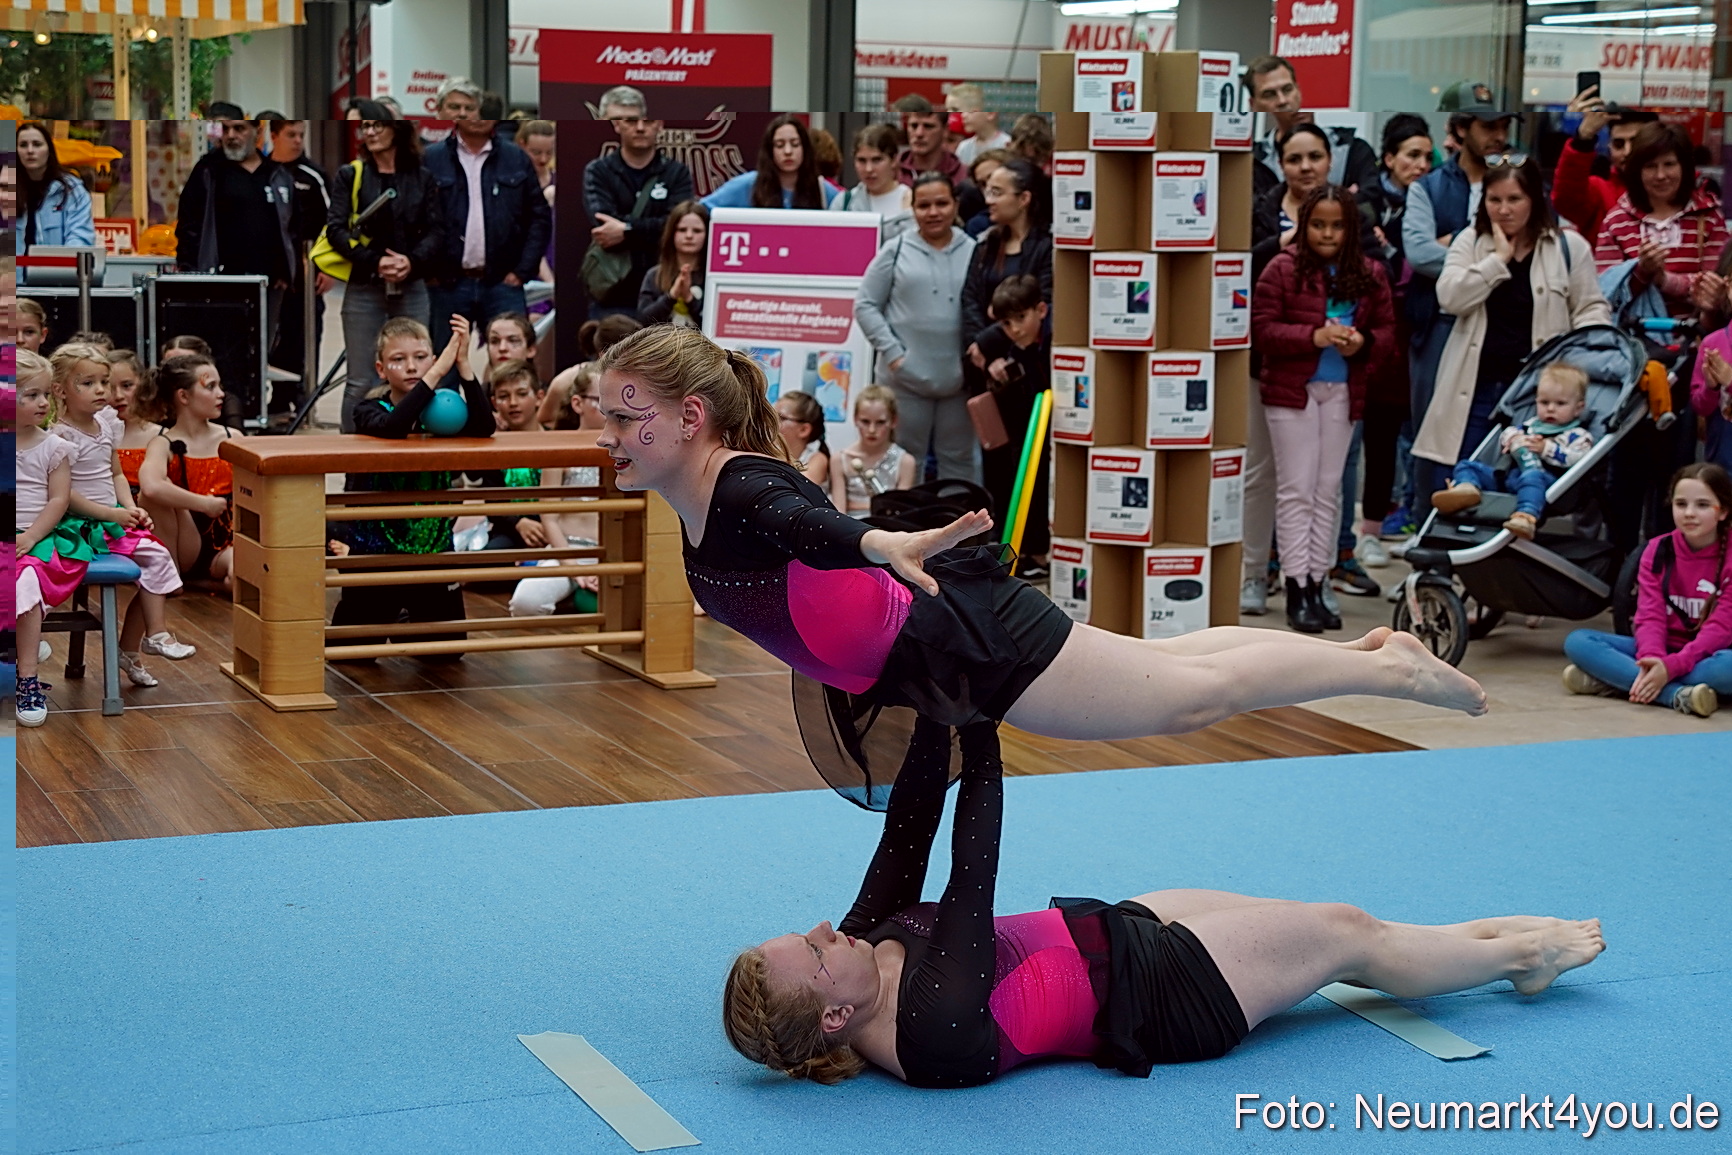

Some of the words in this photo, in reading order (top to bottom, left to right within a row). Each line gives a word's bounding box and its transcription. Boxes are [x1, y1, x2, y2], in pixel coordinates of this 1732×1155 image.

[1290, 0, 1339, 26] Stunde
[855, 48, 949, 69] henkideen
[1600, 42, 1712, 70] SOFTWAR
[1666, 594, 1706, 618] PUM
